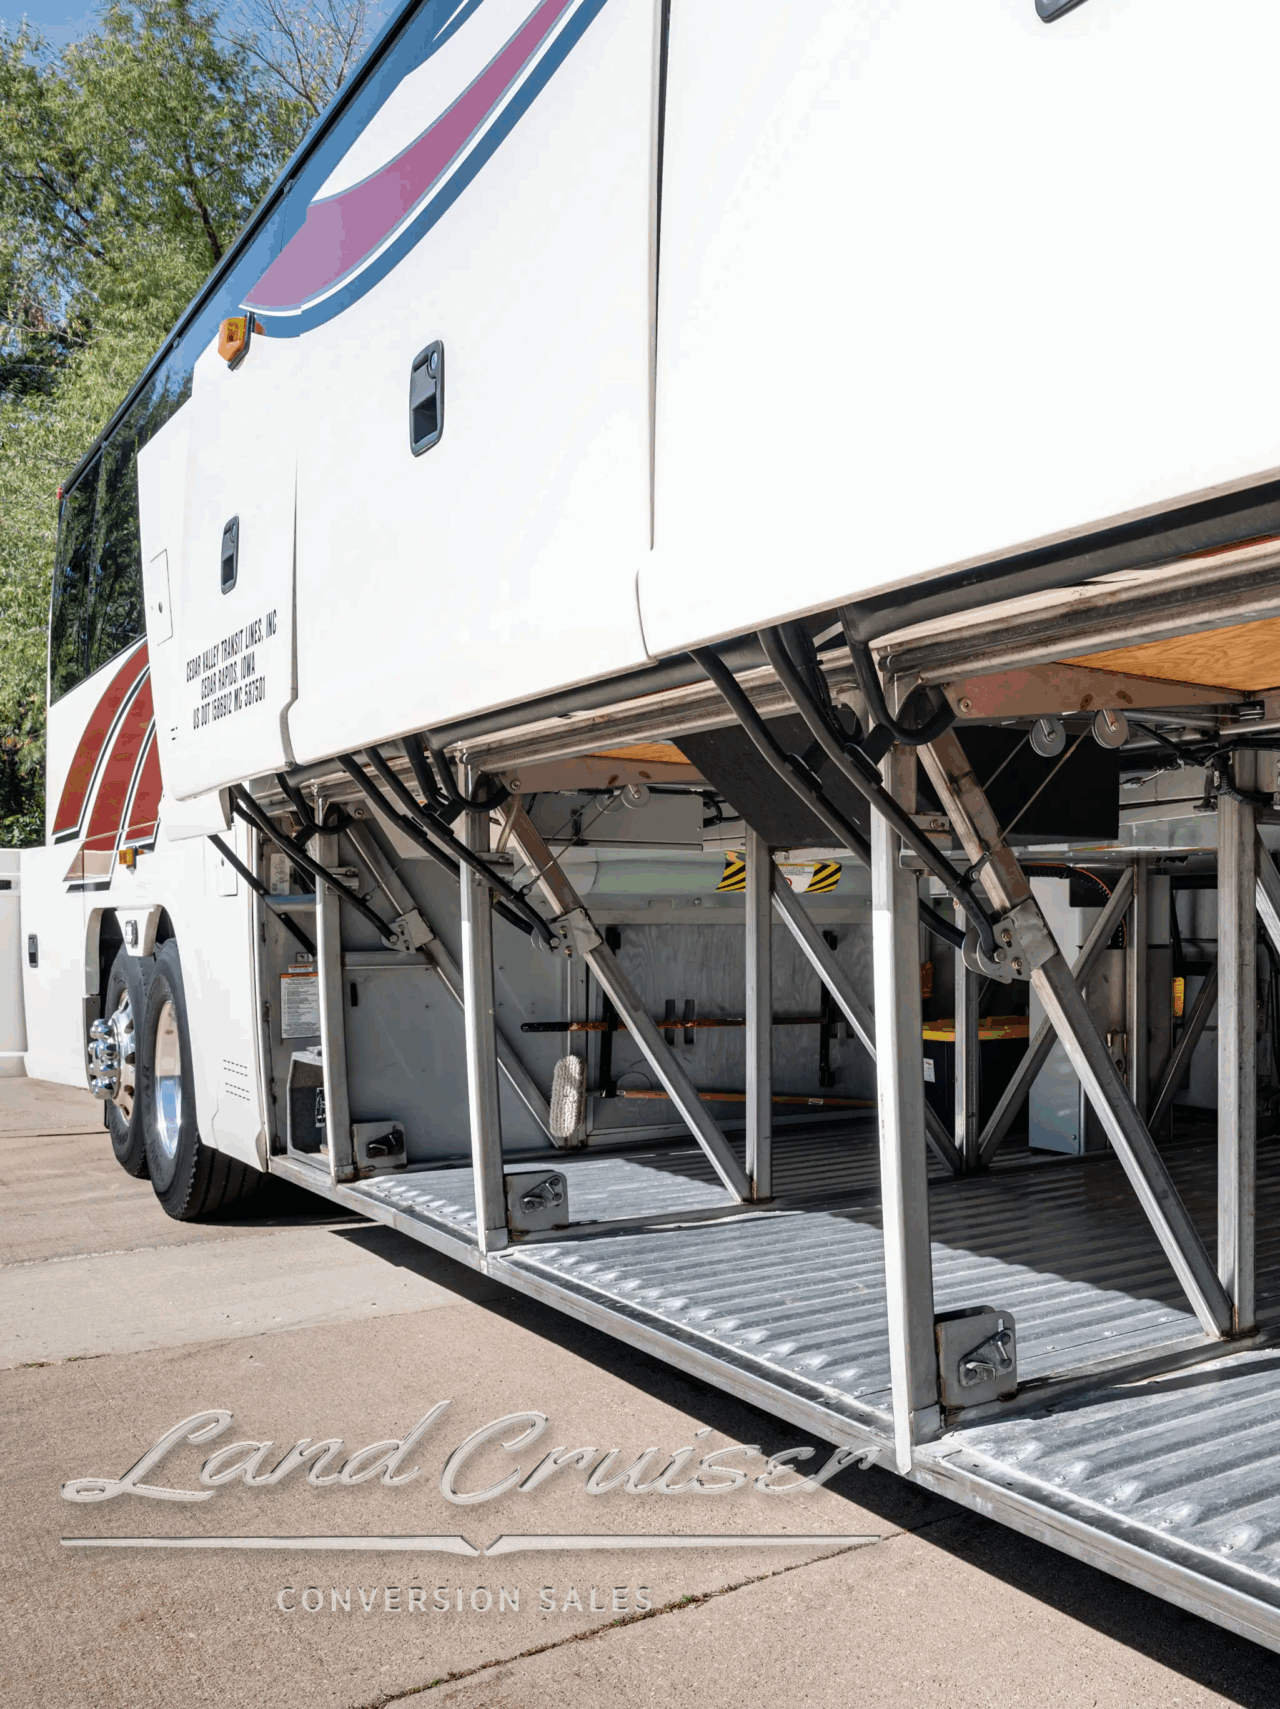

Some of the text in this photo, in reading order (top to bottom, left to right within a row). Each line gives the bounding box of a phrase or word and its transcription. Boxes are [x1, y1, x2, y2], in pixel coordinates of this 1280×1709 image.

[186, 655, 202, 683] CEDAR
[202, 643, 220, 674] VALLEY
[221, 628, 244, 663] TRANSIT
[265, 608, 277, 639] INC
[201, 672, 217, 701] CEDAR
[240, 650, 256, 681] IOWA
[193, 707, 200, 731] US
[201, 701, 211, 727] DOT
[233, 685, 243, 713] MC
